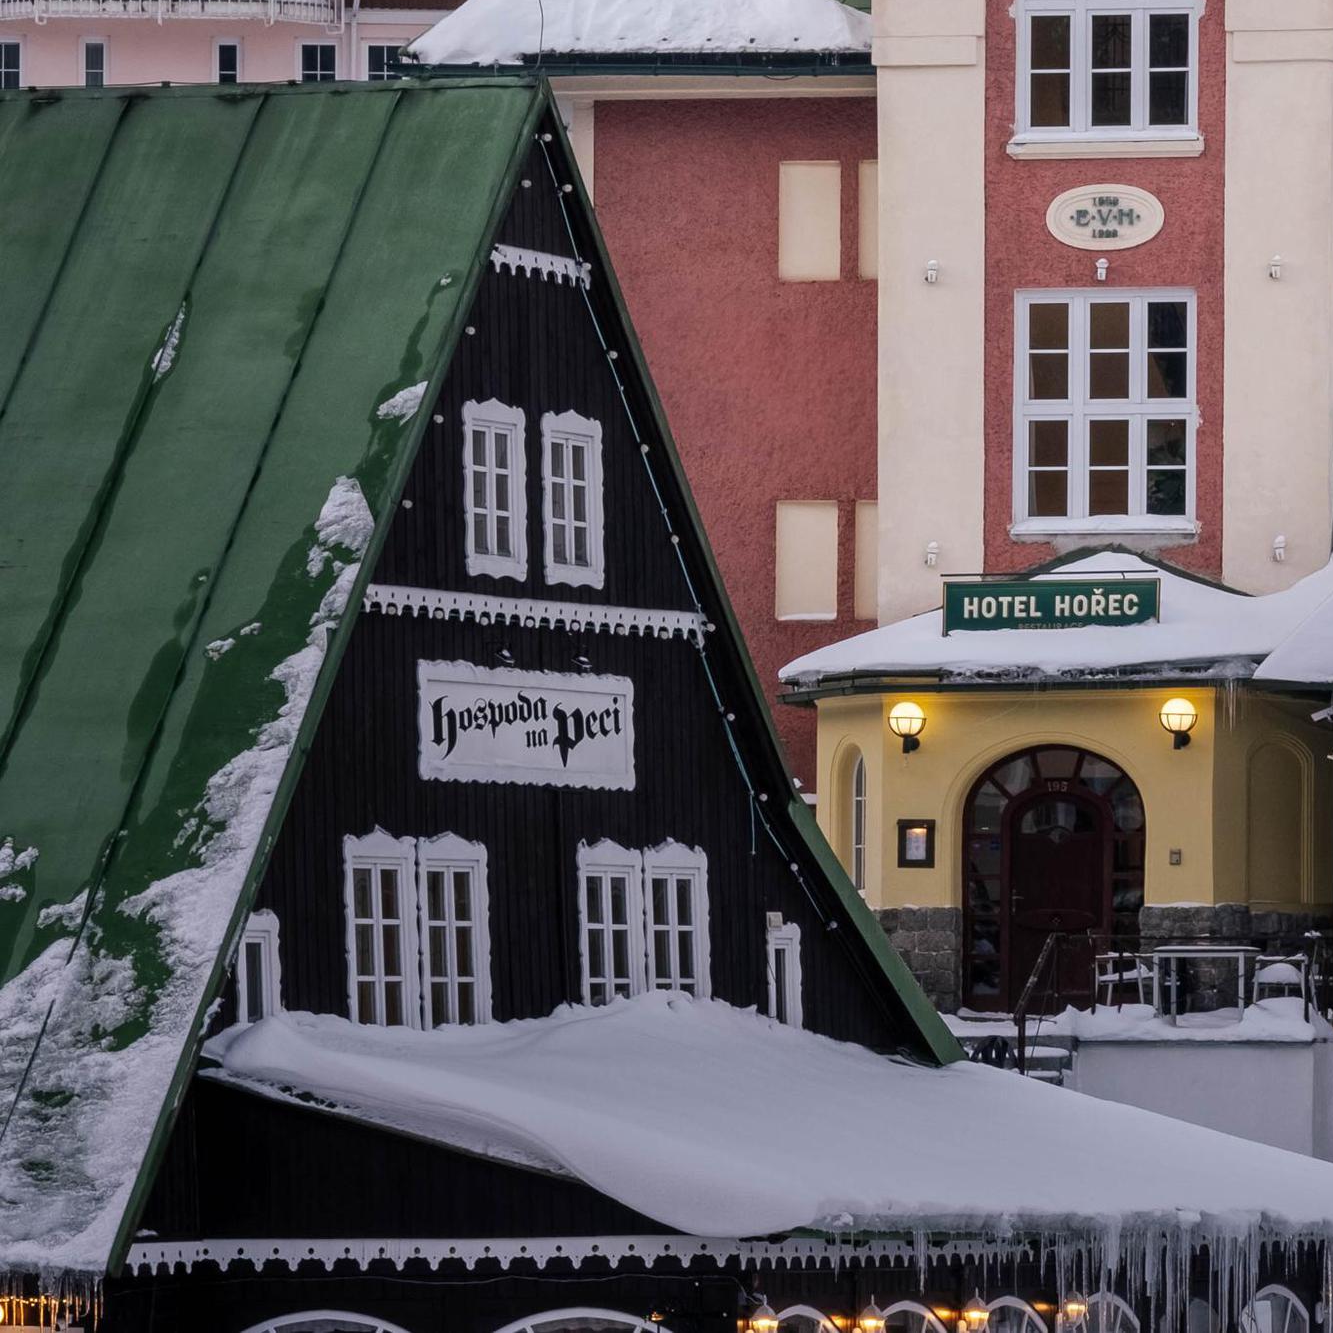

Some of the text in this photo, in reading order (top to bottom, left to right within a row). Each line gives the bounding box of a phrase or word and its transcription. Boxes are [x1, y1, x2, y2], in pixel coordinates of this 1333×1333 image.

[963, 588, 1139, 618] HOTEL HOŘEC
[525, 728, 548, 748] na
